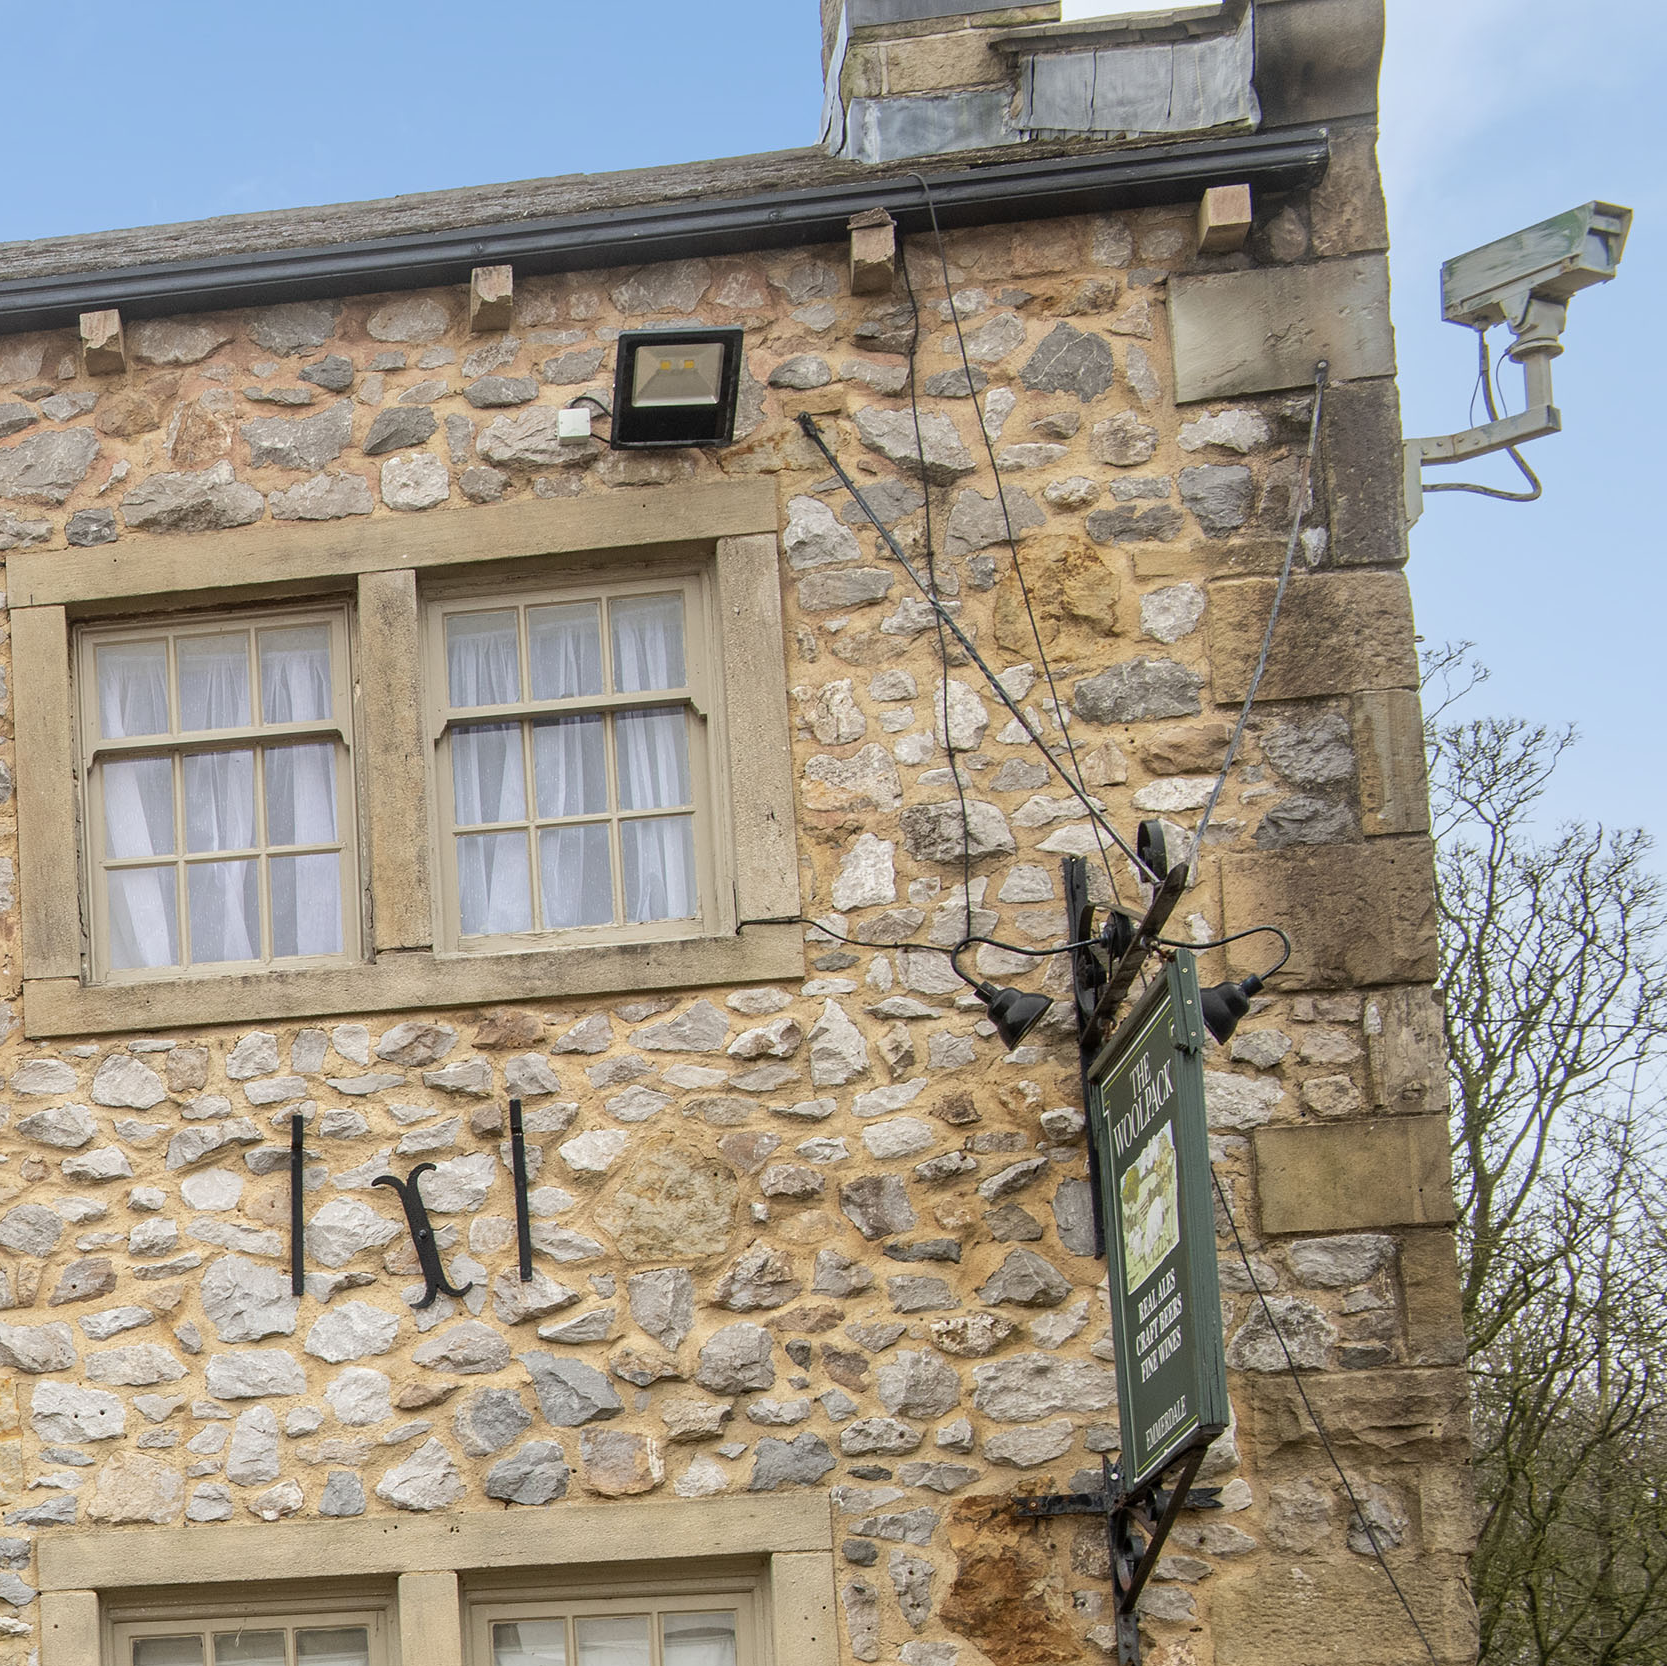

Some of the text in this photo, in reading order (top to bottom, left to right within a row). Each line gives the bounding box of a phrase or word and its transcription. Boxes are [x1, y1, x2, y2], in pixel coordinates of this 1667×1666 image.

[1129, 1051, 1152, 1100] THE
[1113, 1057, 1175, 1159] WOOLPACK
[1135, 1292, 1183, 1357] CRAFT BEERS
[1137, 1267, 1177, 1325] REAL ALES
[1140, 1325, 1182, 1384] FINE WINES
[1145, 1394, 1188, 1452] EMMERDALE
